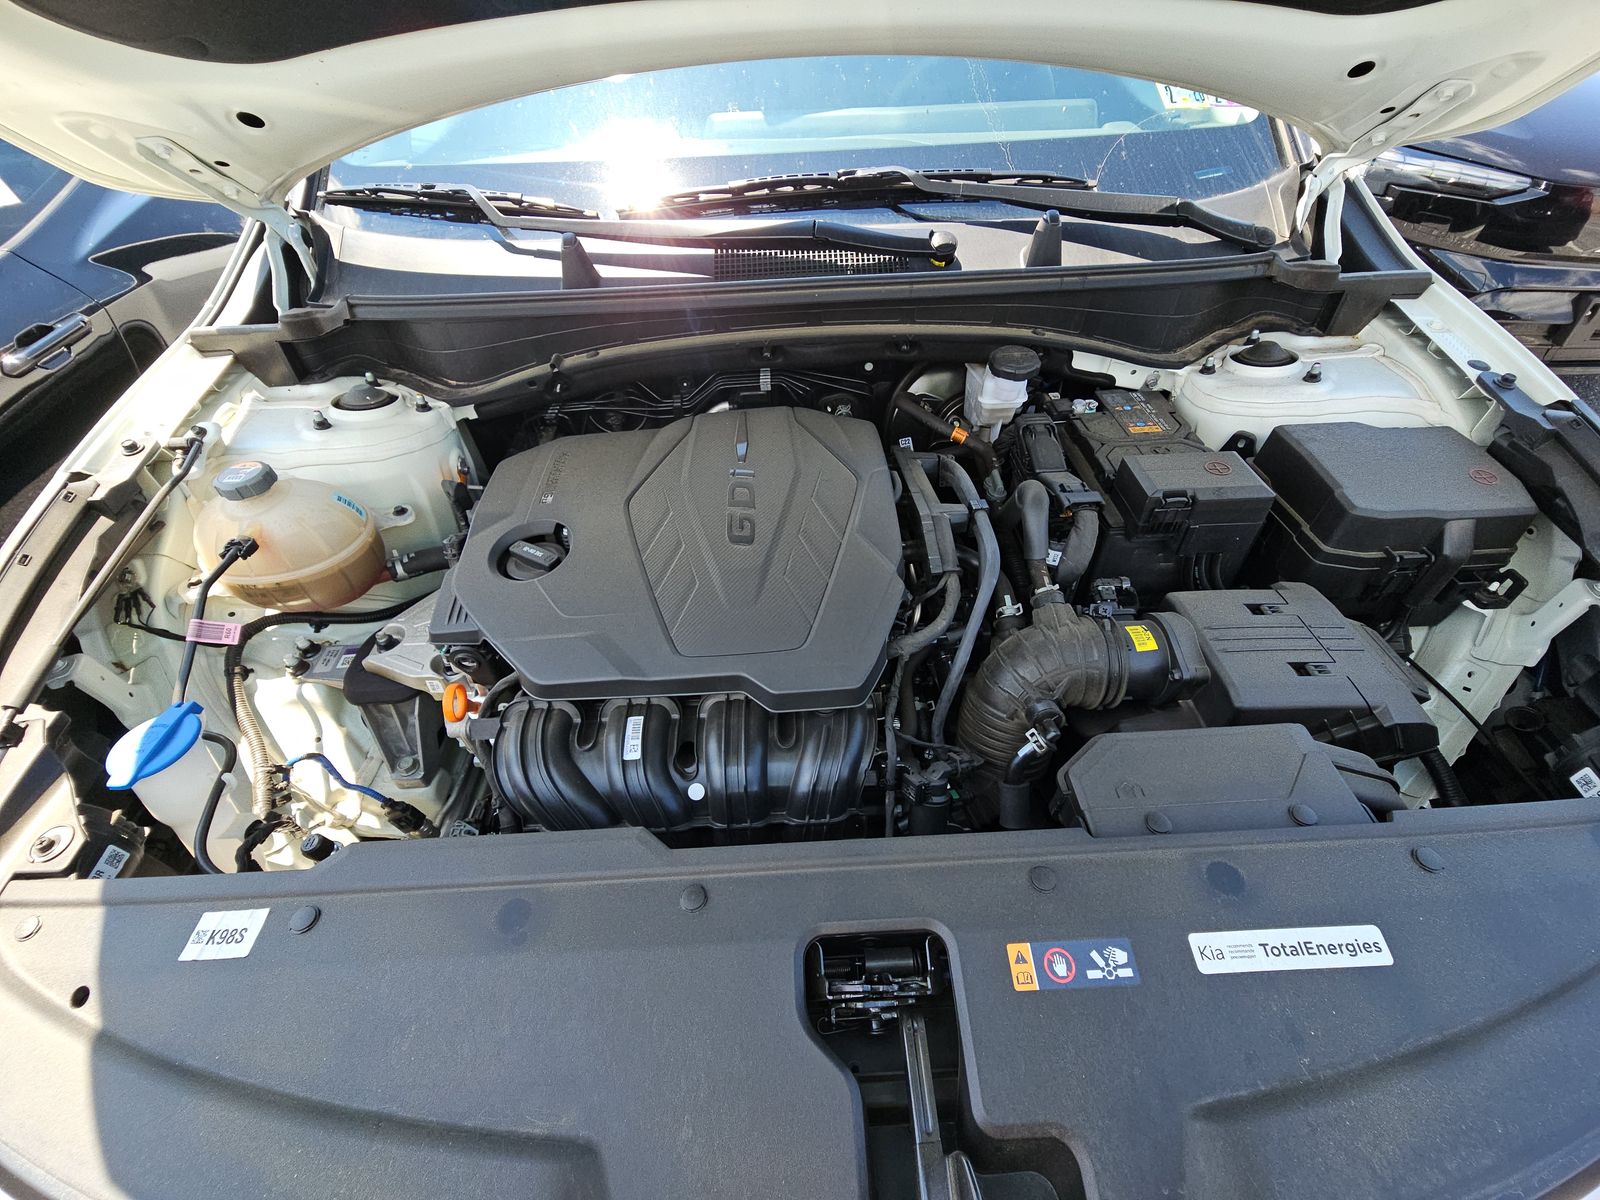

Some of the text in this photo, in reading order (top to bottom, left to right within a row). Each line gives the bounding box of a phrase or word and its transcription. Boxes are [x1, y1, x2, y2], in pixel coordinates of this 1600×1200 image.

[205, 927, 249, 946] K98S
[1197, 938, 1383, 961] Kia TotalEnergies
